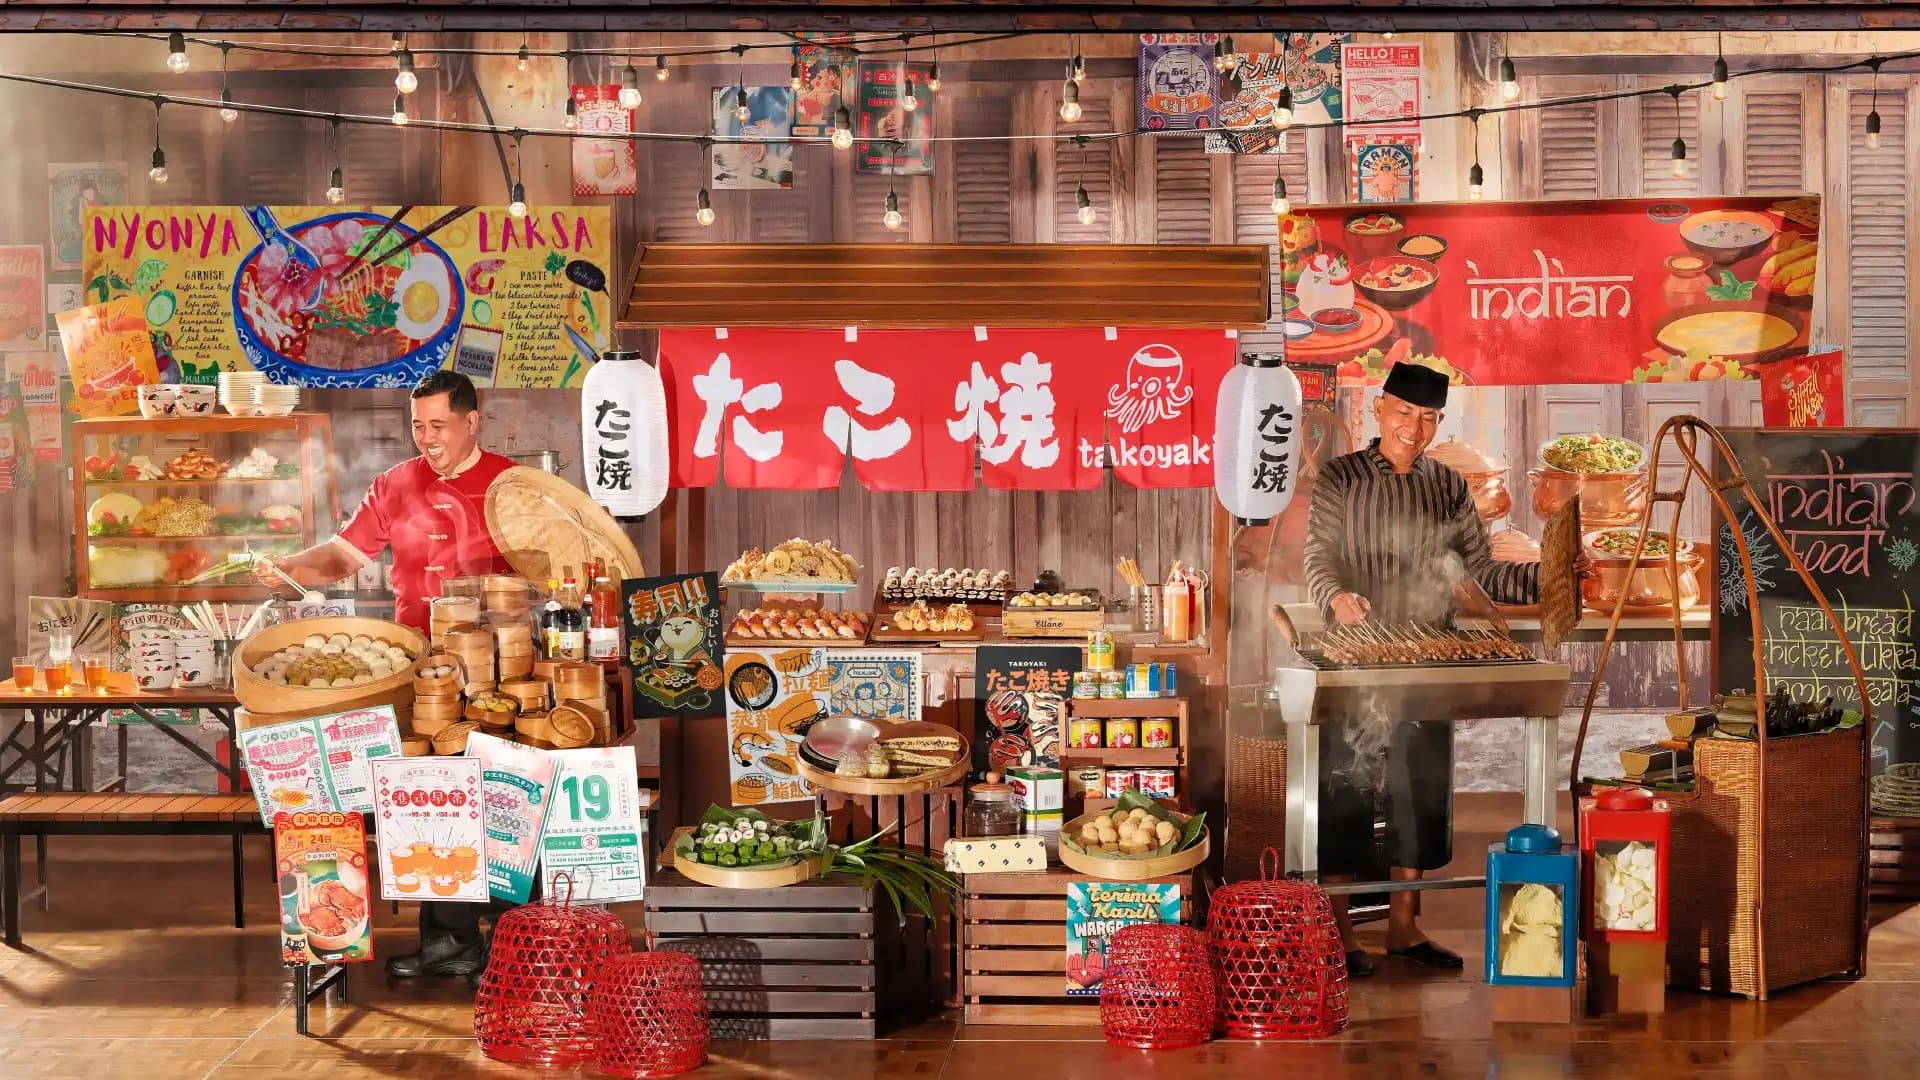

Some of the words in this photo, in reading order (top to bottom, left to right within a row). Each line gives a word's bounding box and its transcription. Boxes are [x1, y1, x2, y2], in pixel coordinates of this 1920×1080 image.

[1347, 47, 1394, 60] HELLO!
[1363, 147, 1409, 169] RAMEN
[94, 213, 240, 258] NYONYA
[479, 211, 593, 252] LAKSA
[185, 270, 225, 281] GARNISH
[520, 270, 548, 281] PASTE
[1467, 249, 1633, 321] indian
[692, 351, 1061, 470] たこ焼
[594, 398, 633, 492] たこ焼
[1252, 402, 1293, 494] たこ焼
[1761, 449, 1916, 529] indian
[37, 613, 79, 633] おにぎり
[1776, 604, 1834, 634] naan
[1835, 588, 1917, 638] bread
[1752, 625, 1850, 671] chicken
[986, 668, 1070, 692] たこ焼き
[561, 774, 611, 822] 19
